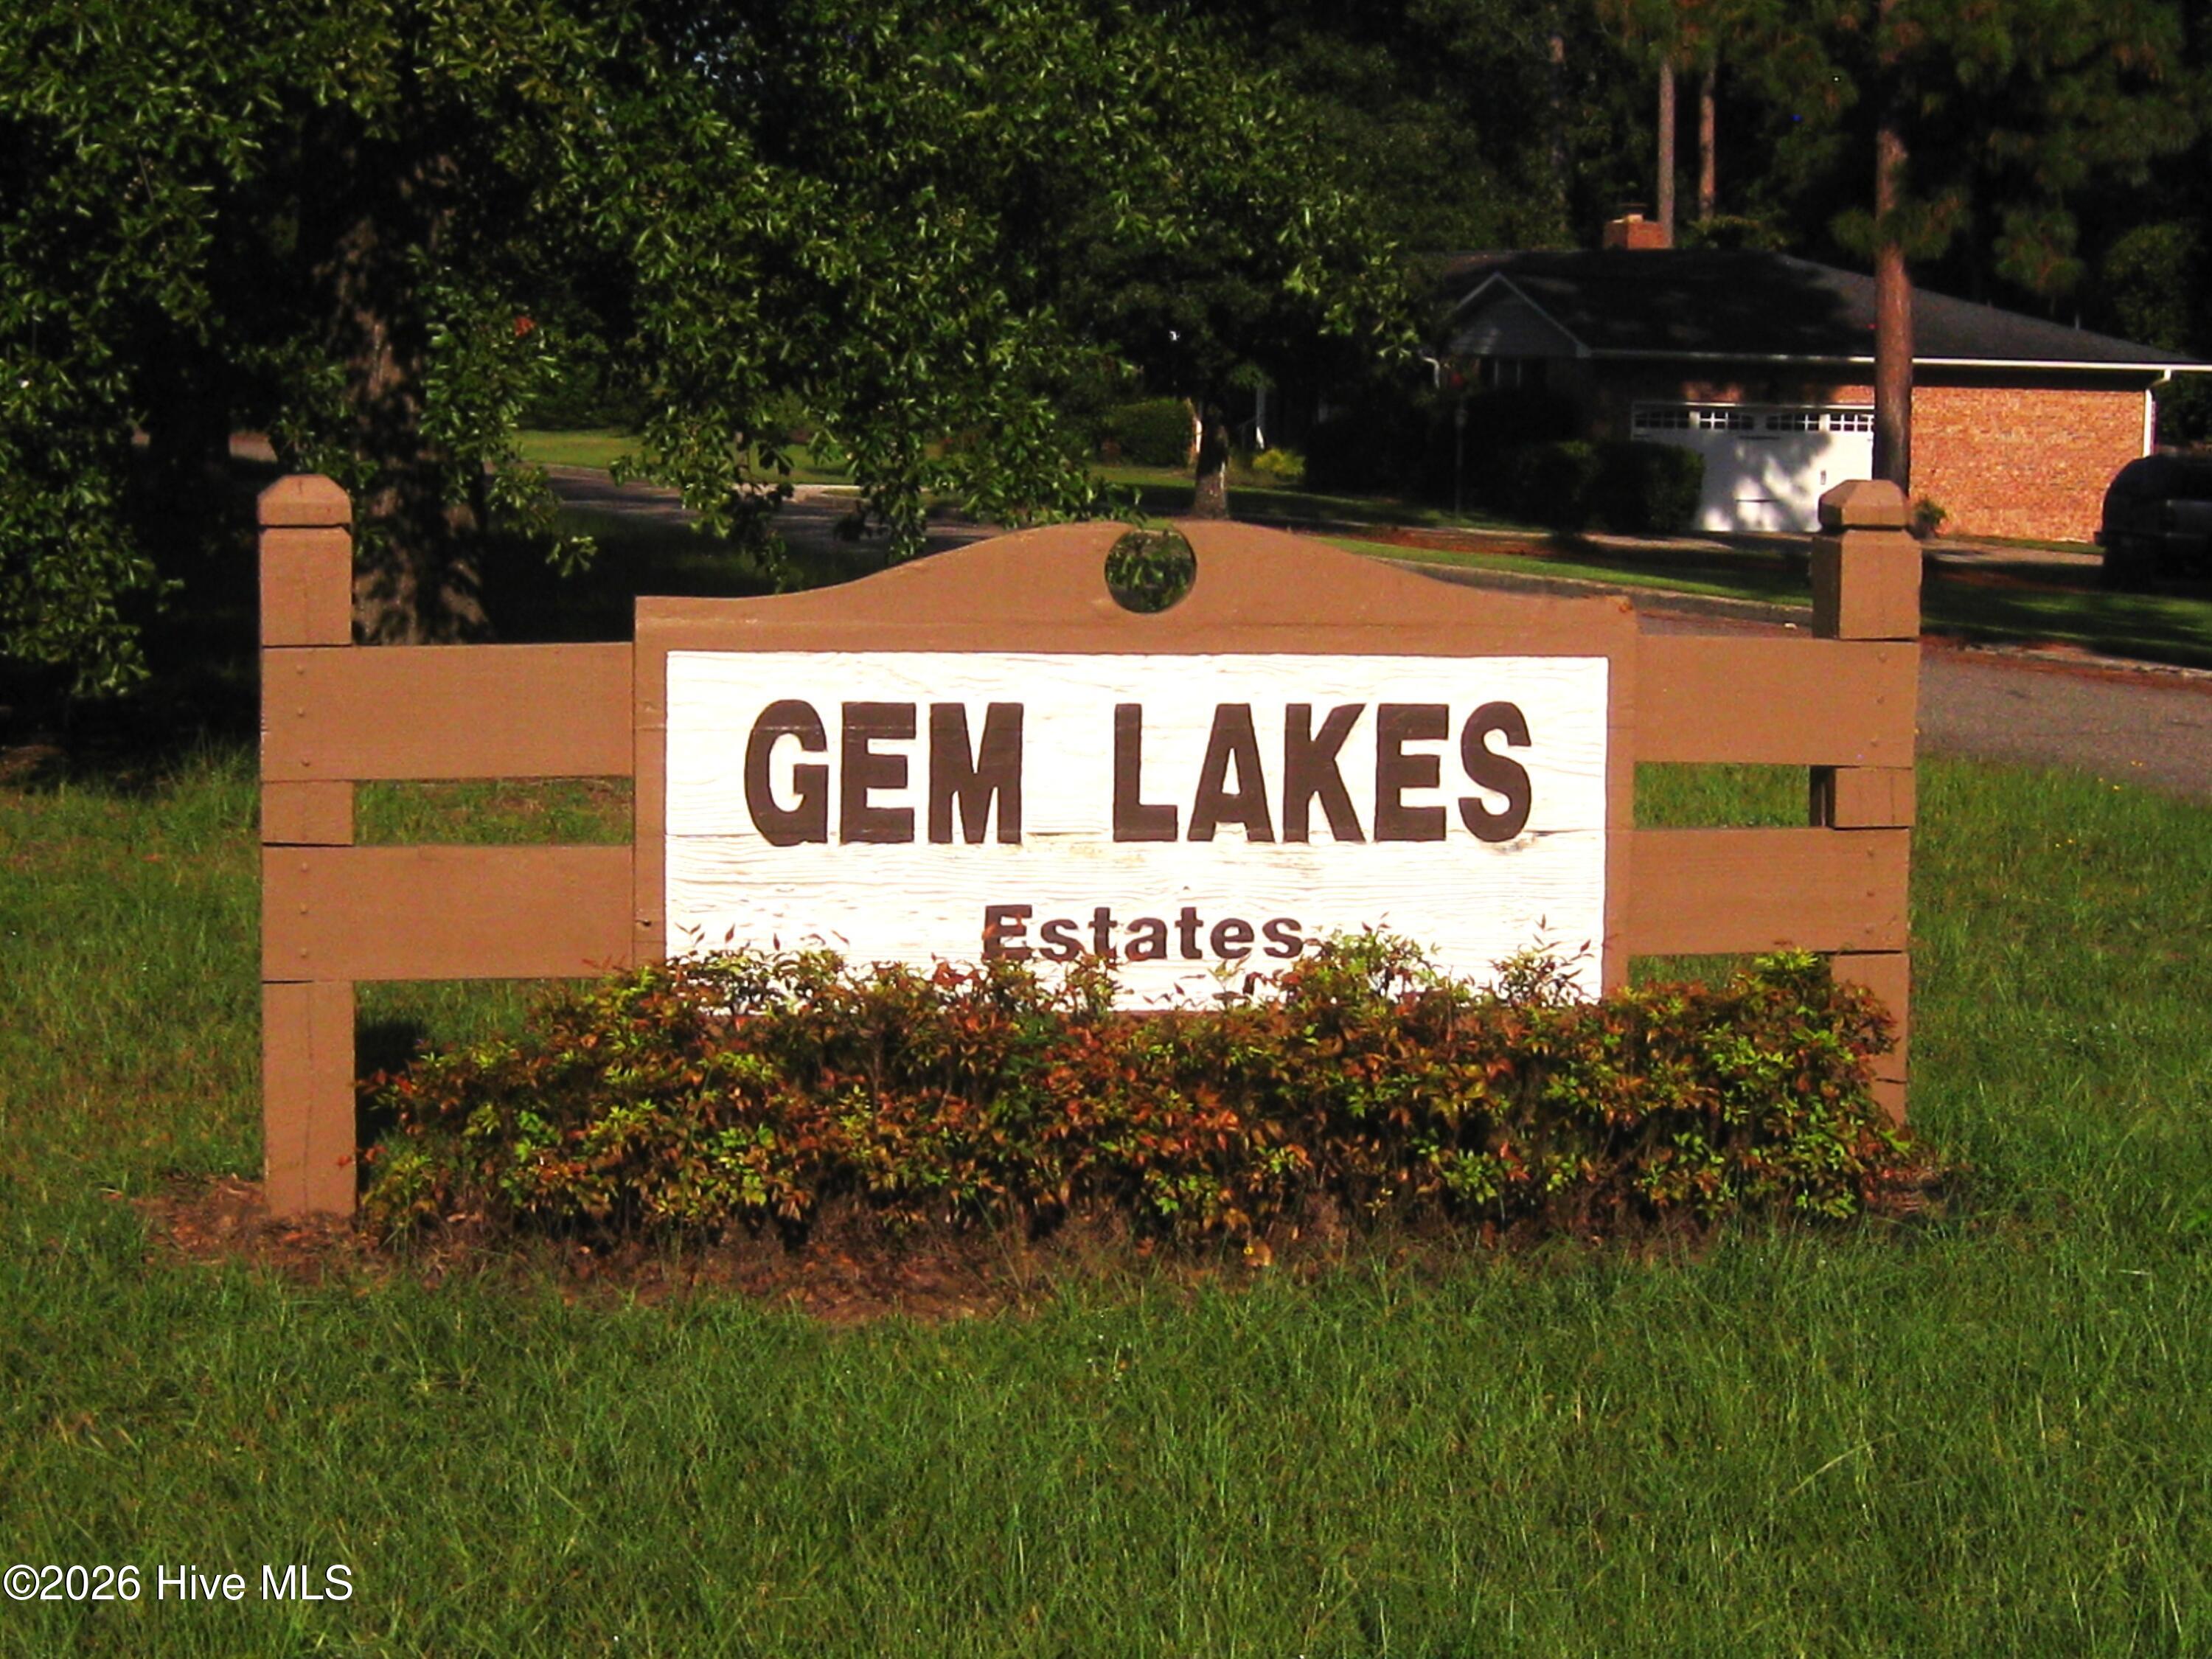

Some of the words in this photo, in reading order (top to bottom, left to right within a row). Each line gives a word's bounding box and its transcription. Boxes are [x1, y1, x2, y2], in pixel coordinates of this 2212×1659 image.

[744, 700, 1024, 847] GEM
[1113, 701, 1533, 844] LAKES
[983, 904, 1304, 960] Estates
